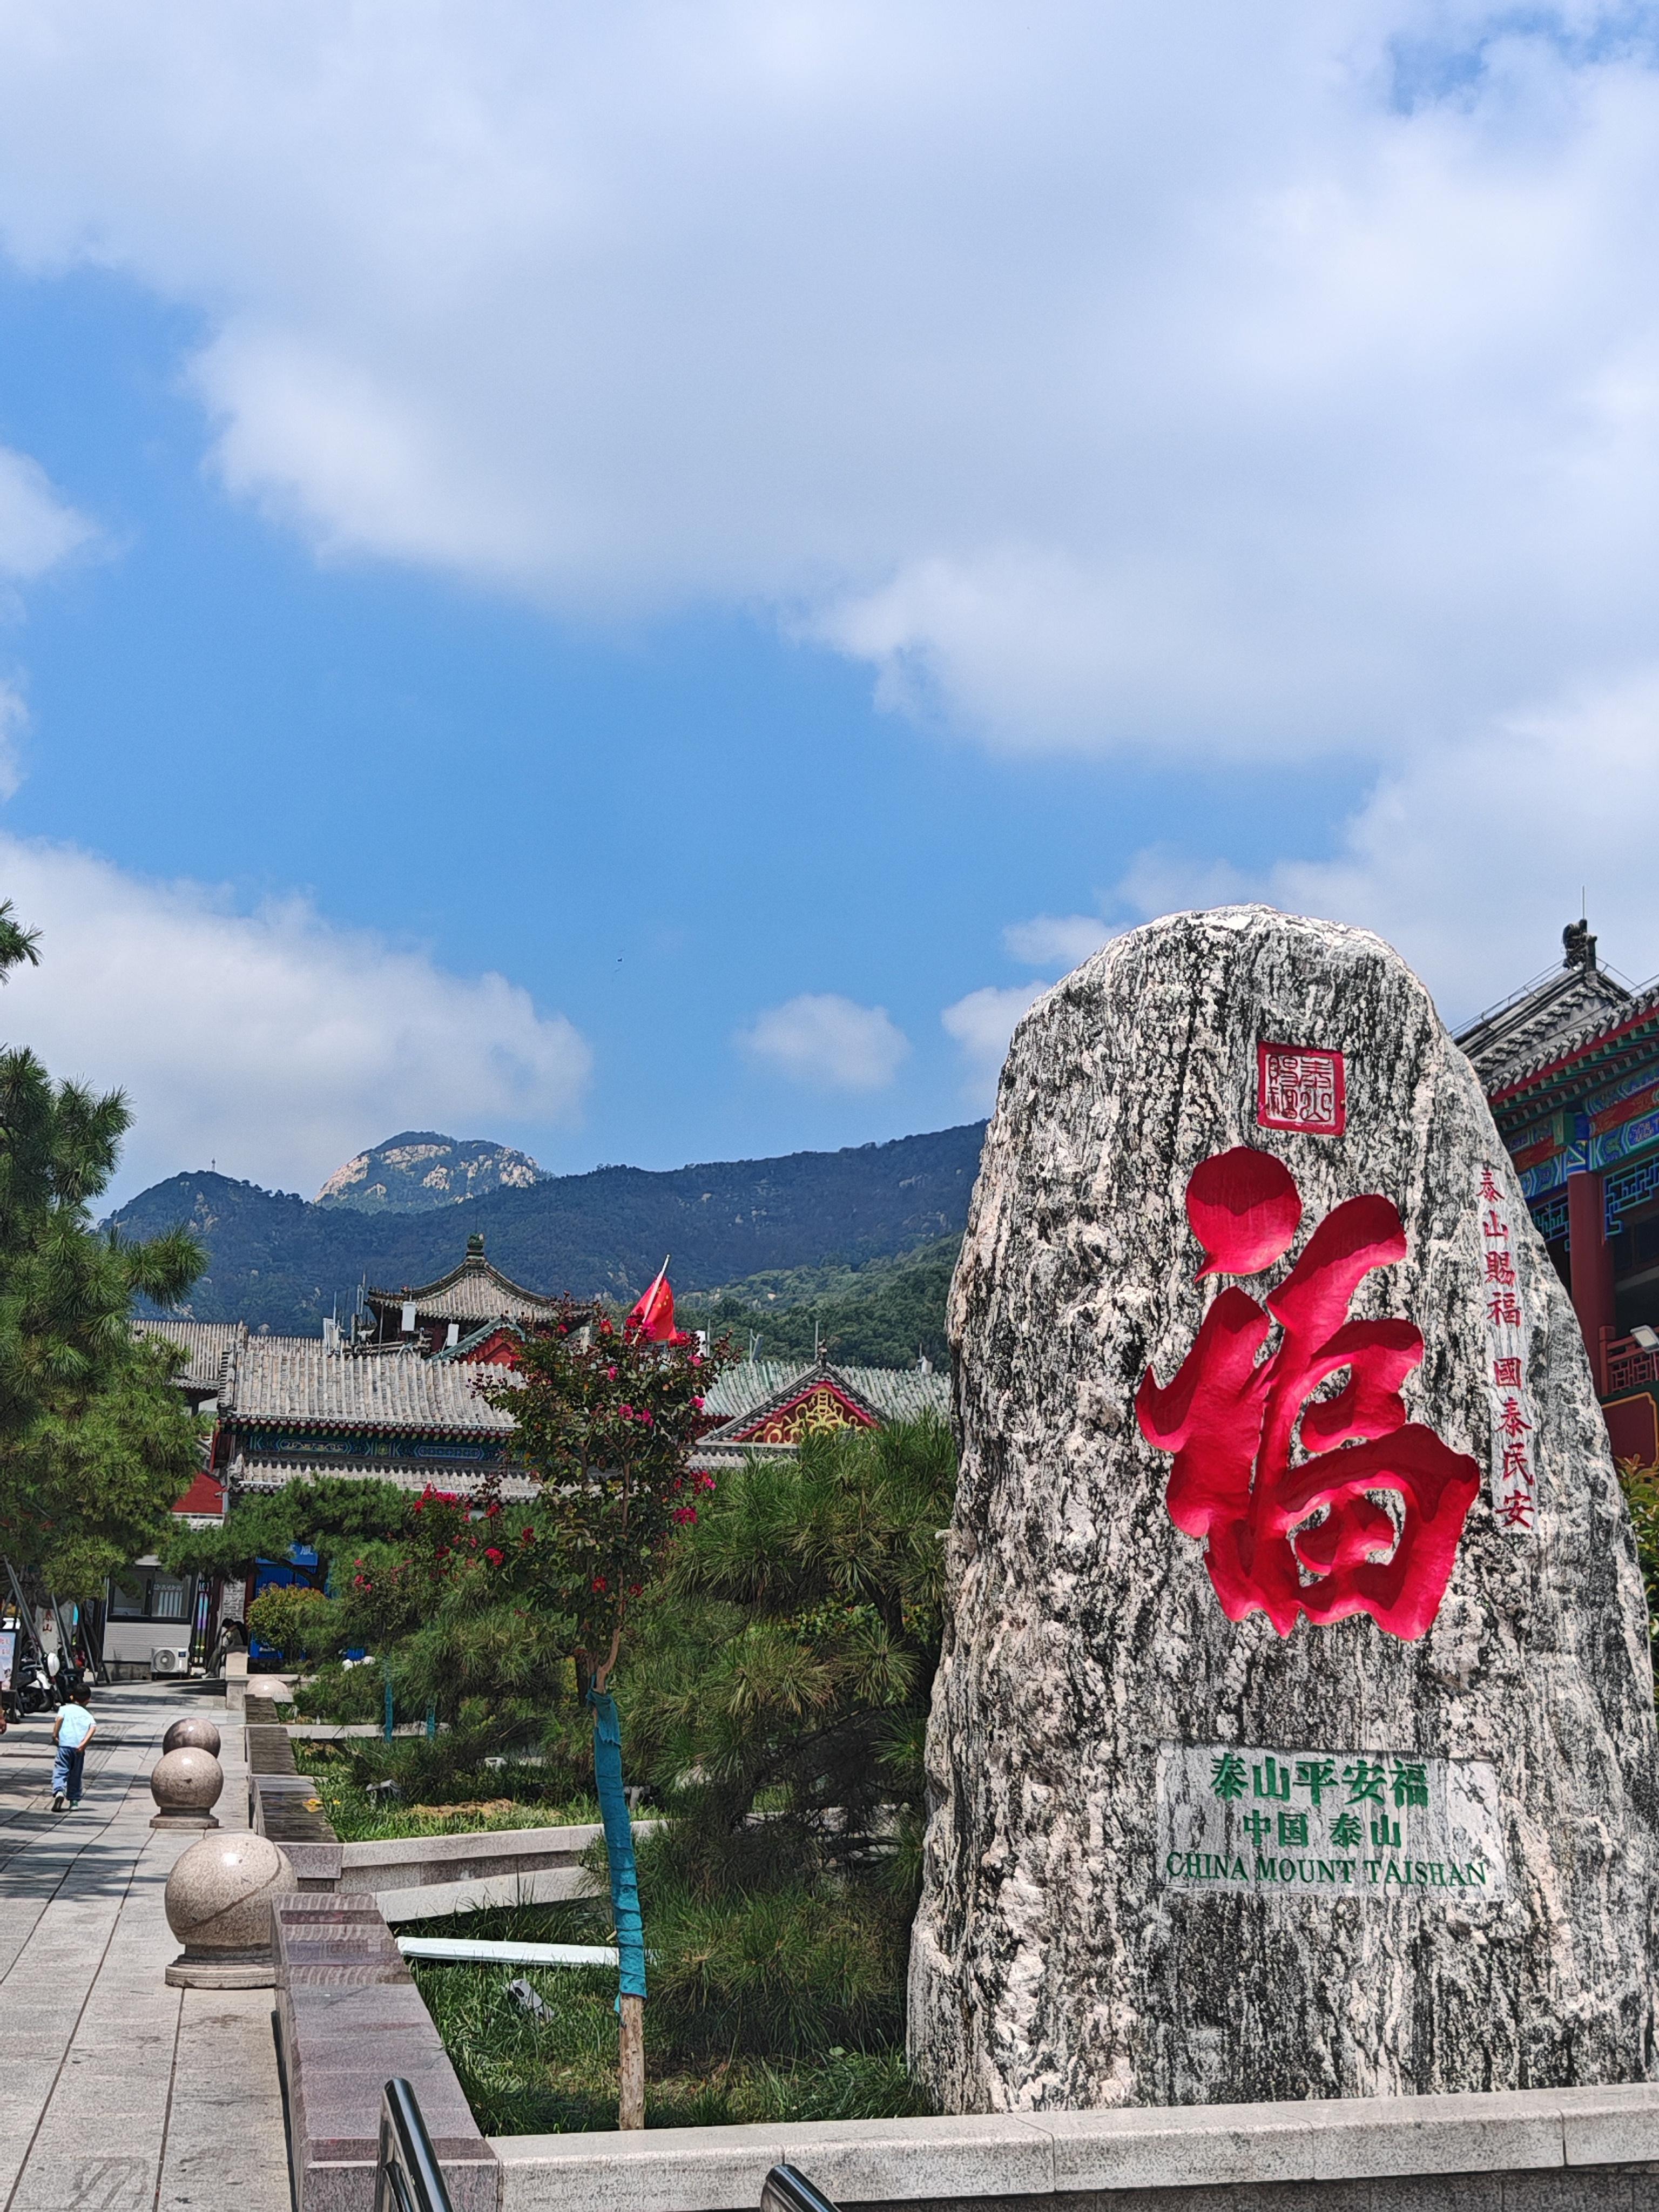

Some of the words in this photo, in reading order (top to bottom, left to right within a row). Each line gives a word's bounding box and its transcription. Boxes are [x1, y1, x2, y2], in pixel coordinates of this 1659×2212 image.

[1135, 1145, 1480, 1641] 福
[1494, 1357, 1534, 1528] 國泰民安
[1210, 1752, 1429, 1808] 泰山平安福
[1166, 1851, 1248, 1881] CHINA
[1256, 1857, 1356, 1884] MOUNT
[1363, 1859, 1487, 1887] TAISHAN
